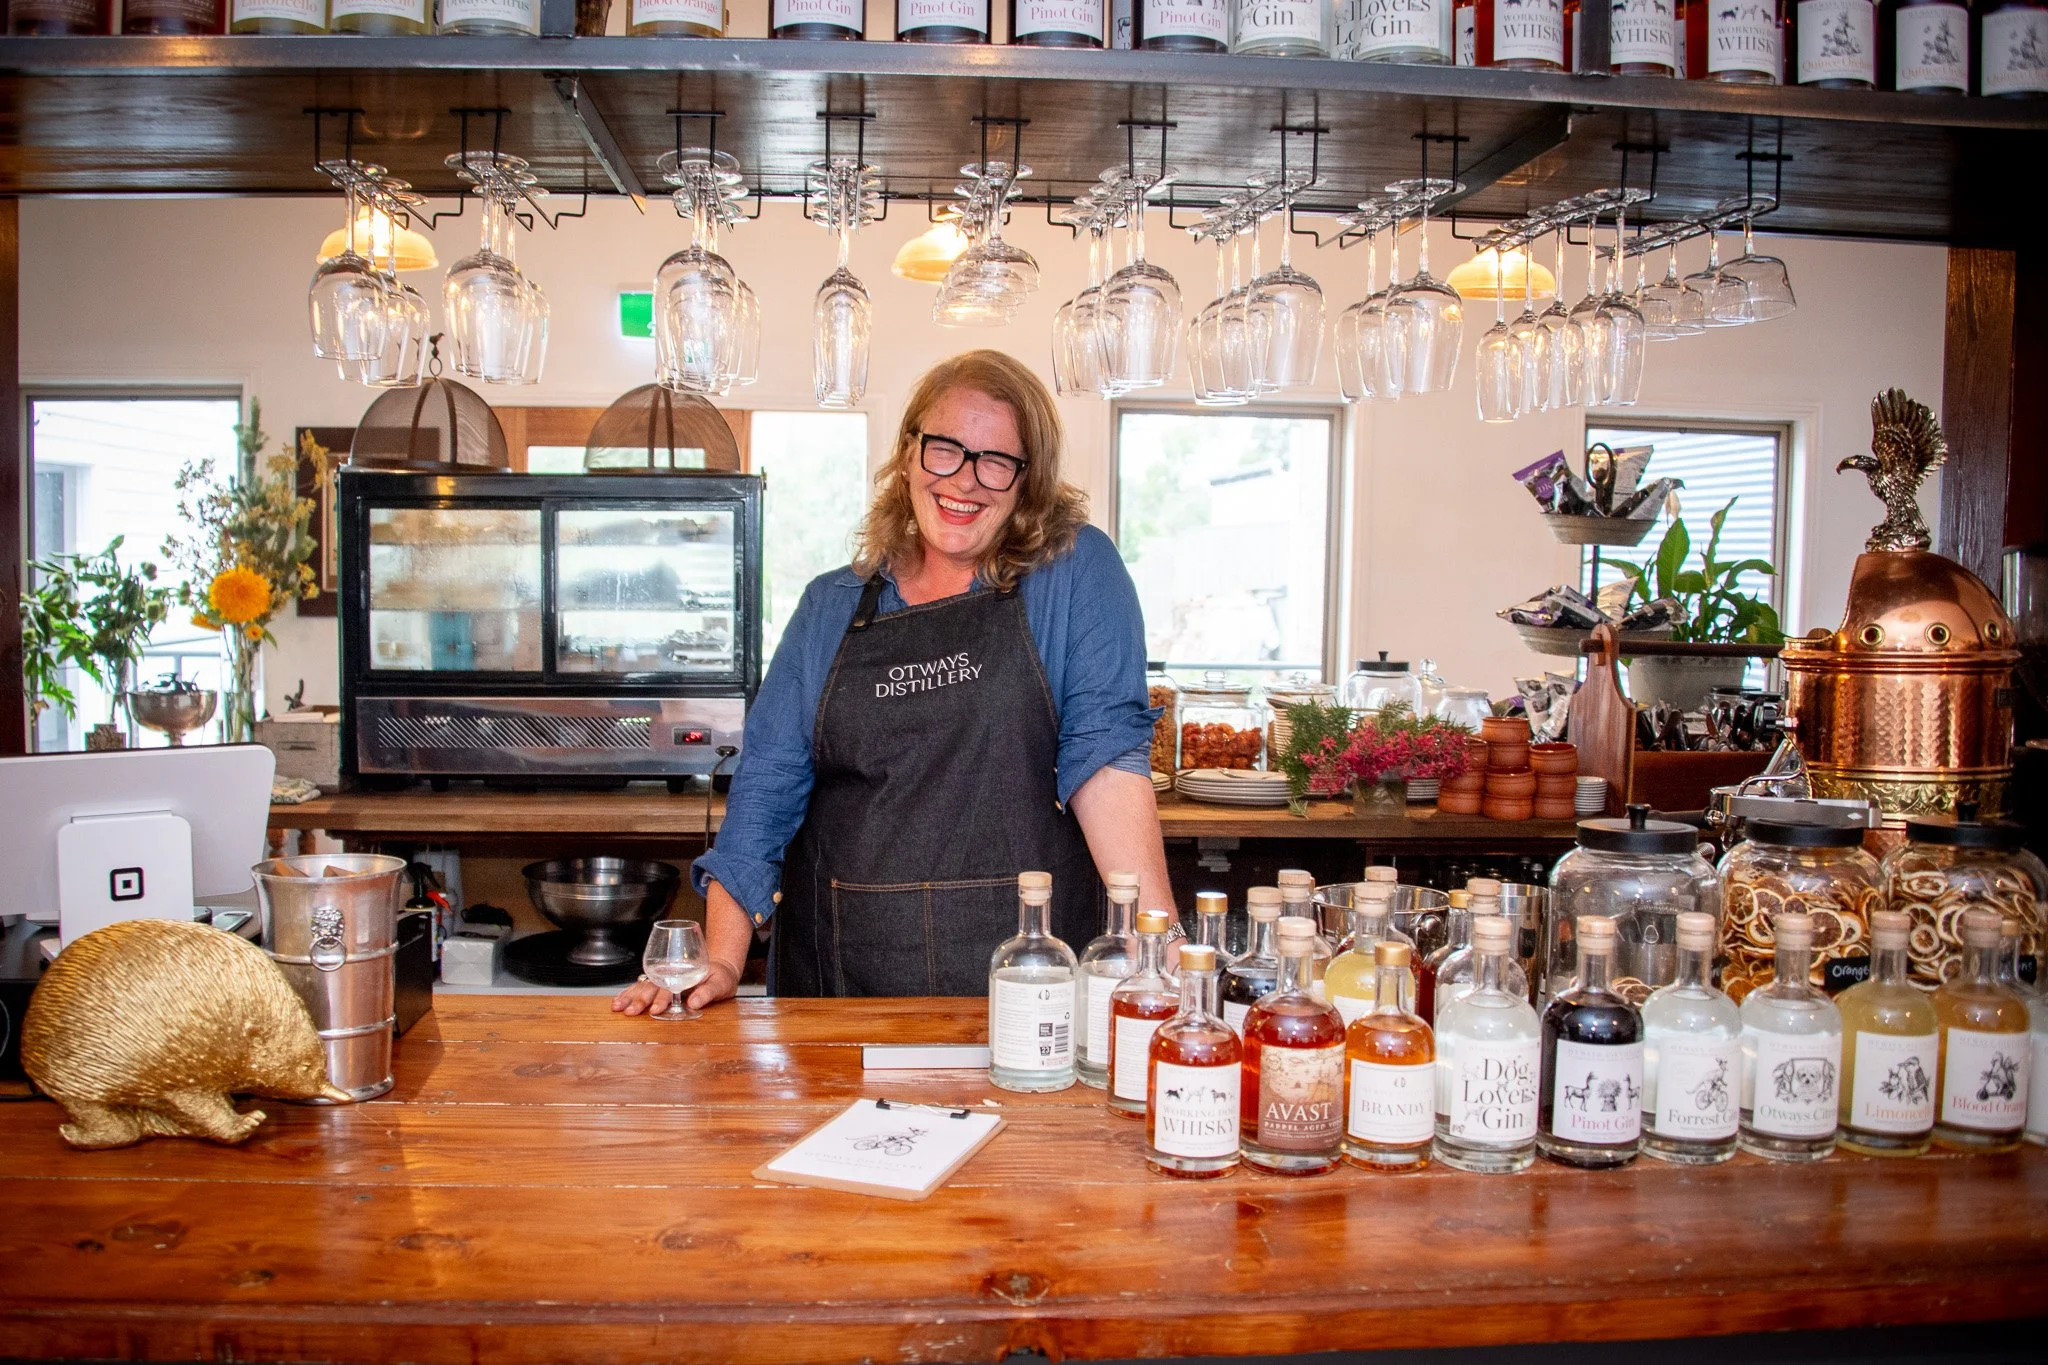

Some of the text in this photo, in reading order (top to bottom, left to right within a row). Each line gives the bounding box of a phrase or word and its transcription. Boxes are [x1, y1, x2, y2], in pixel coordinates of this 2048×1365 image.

[910, 1, 975, 17] Pinot Gin
[1031, 6, 1094, 24] Pinot Gin
[1252, 5, 1294, 27] Gin
[1160, 10, 1222, 28] Pinot Gin
[1370, 14, 1411, 38] Gin
[888, 652, 970, 681] OTWAYS
[875, 664, 983, 698] DISTILLERY
[1484, 1058, 1530, 1086] Dog
[1463, 1079, 1537, 1105] Lovers
[1265, 1102, 1332, 1121] AVAST
[1361, 1099, 1425, 1117] BRANDY
[1760, 1105, 1810, 1123] Otways
[1952, 1095, 1993, 1114] Blood
[1163, 1115, 1233, 1136] WHISKY
[1264, 1121, 1299, 1132] BARREL
[1303, 1123, 1327, 1132] AGED
[1482, 1106, 1524, 1130] Gin
[1570, 1114, 1611, 1132] Pinot
[1667, 1109, 1720, 1126] Forrest
